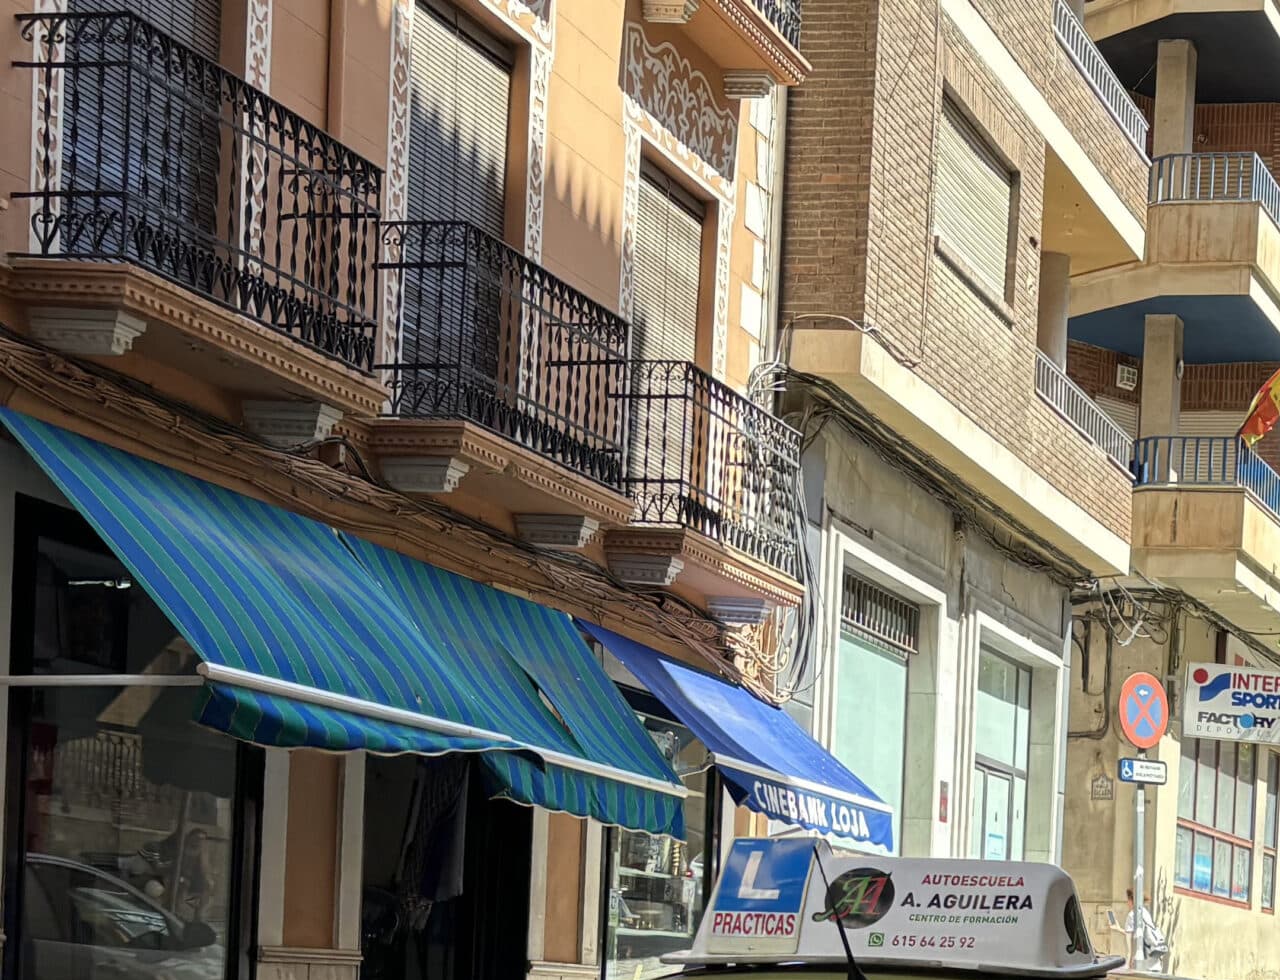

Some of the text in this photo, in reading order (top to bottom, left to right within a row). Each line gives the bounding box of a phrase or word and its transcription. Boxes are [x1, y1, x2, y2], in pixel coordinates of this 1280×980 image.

[1197, 711, 1276, 729] FACTORY
[754, 781, 869, 838] CINEBANK LOJA
[738, 851, 780, 901] L
[921, 873, 1025, 887] AUTOESCUELA
[901, 892, 1033, 910] A. AGUILERA
[712, 912, 795, 936] PRACTICAS
[909, 913, 1018, 924] CENTRO DE FORMACIÓN
[892, 935, 976, 948] 615 64 25 92
